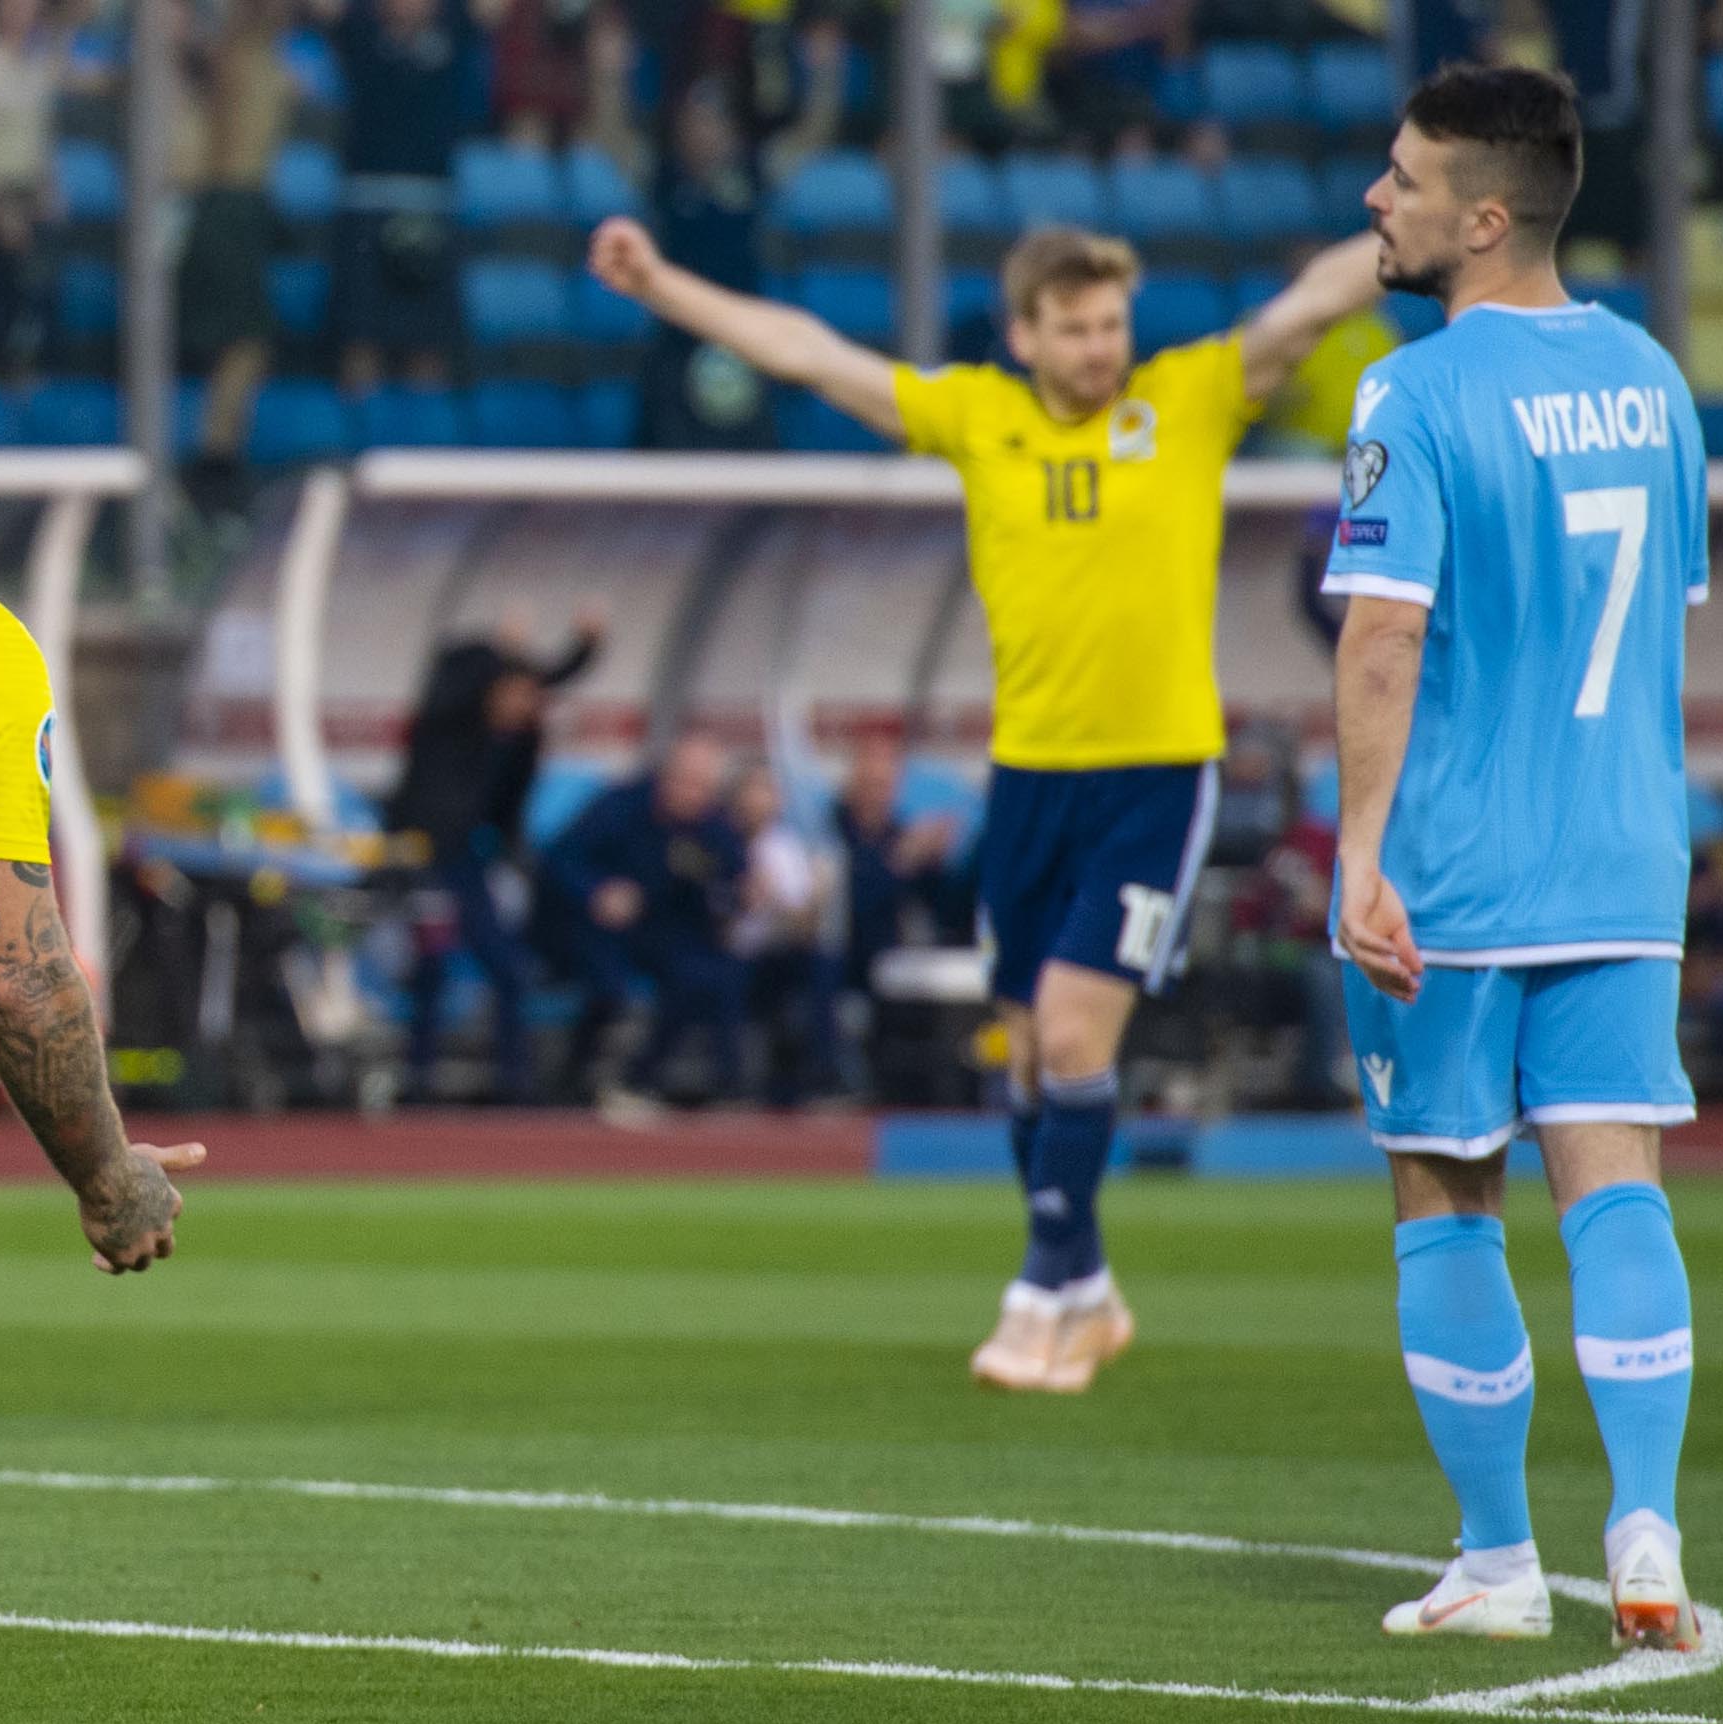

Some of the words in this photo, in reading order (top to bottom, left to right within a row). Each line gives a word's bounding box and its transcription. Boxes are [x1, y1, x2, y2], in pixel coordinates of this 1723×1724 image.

[1512, 386, 1669, 457] VITAIOLI
[1042, 459, 1100, 522] 10
[1563, 485, 1648, 718] 7
